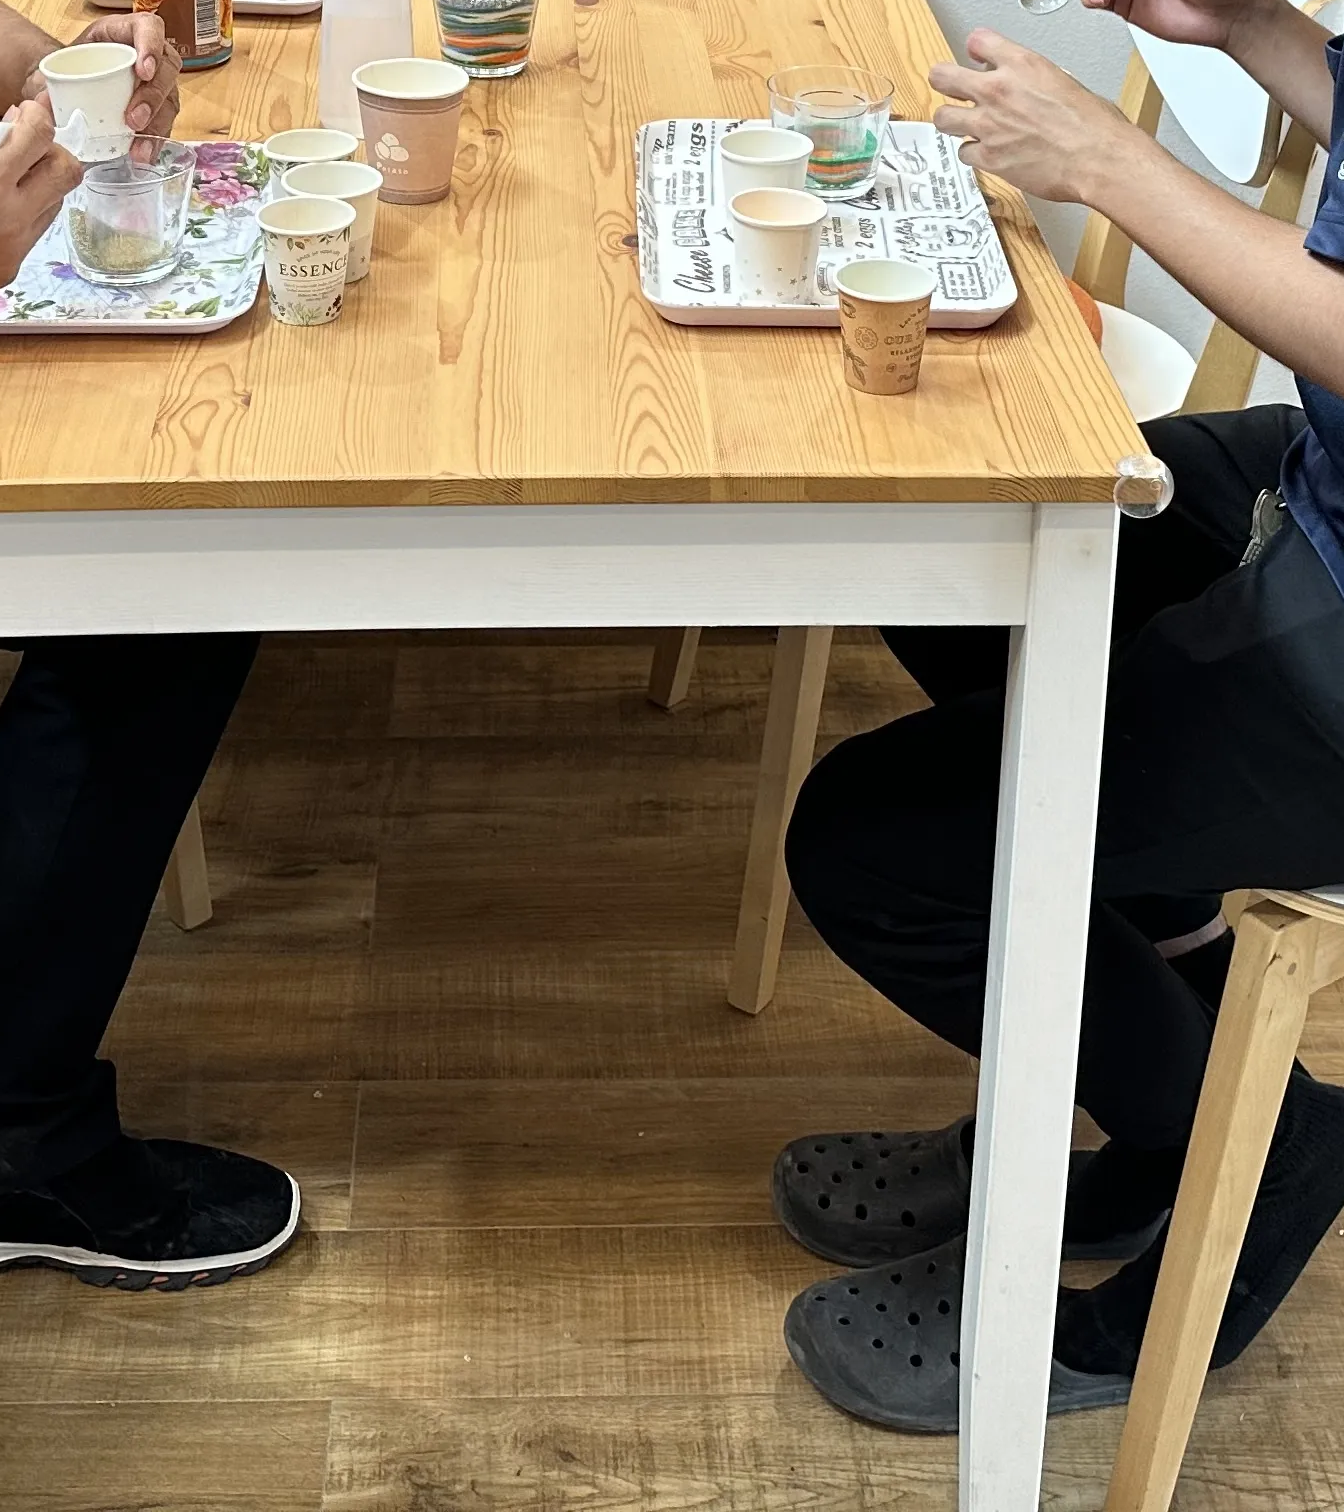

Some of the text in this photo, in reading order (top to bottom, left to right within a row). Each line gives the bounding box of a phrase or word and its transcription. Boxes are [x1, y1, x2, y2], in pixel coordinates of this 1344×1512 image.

[689, 123, 707, 157] eggs
[857, 217, 877, 239] eggs
[672, 248, 717, 294] Cheese
